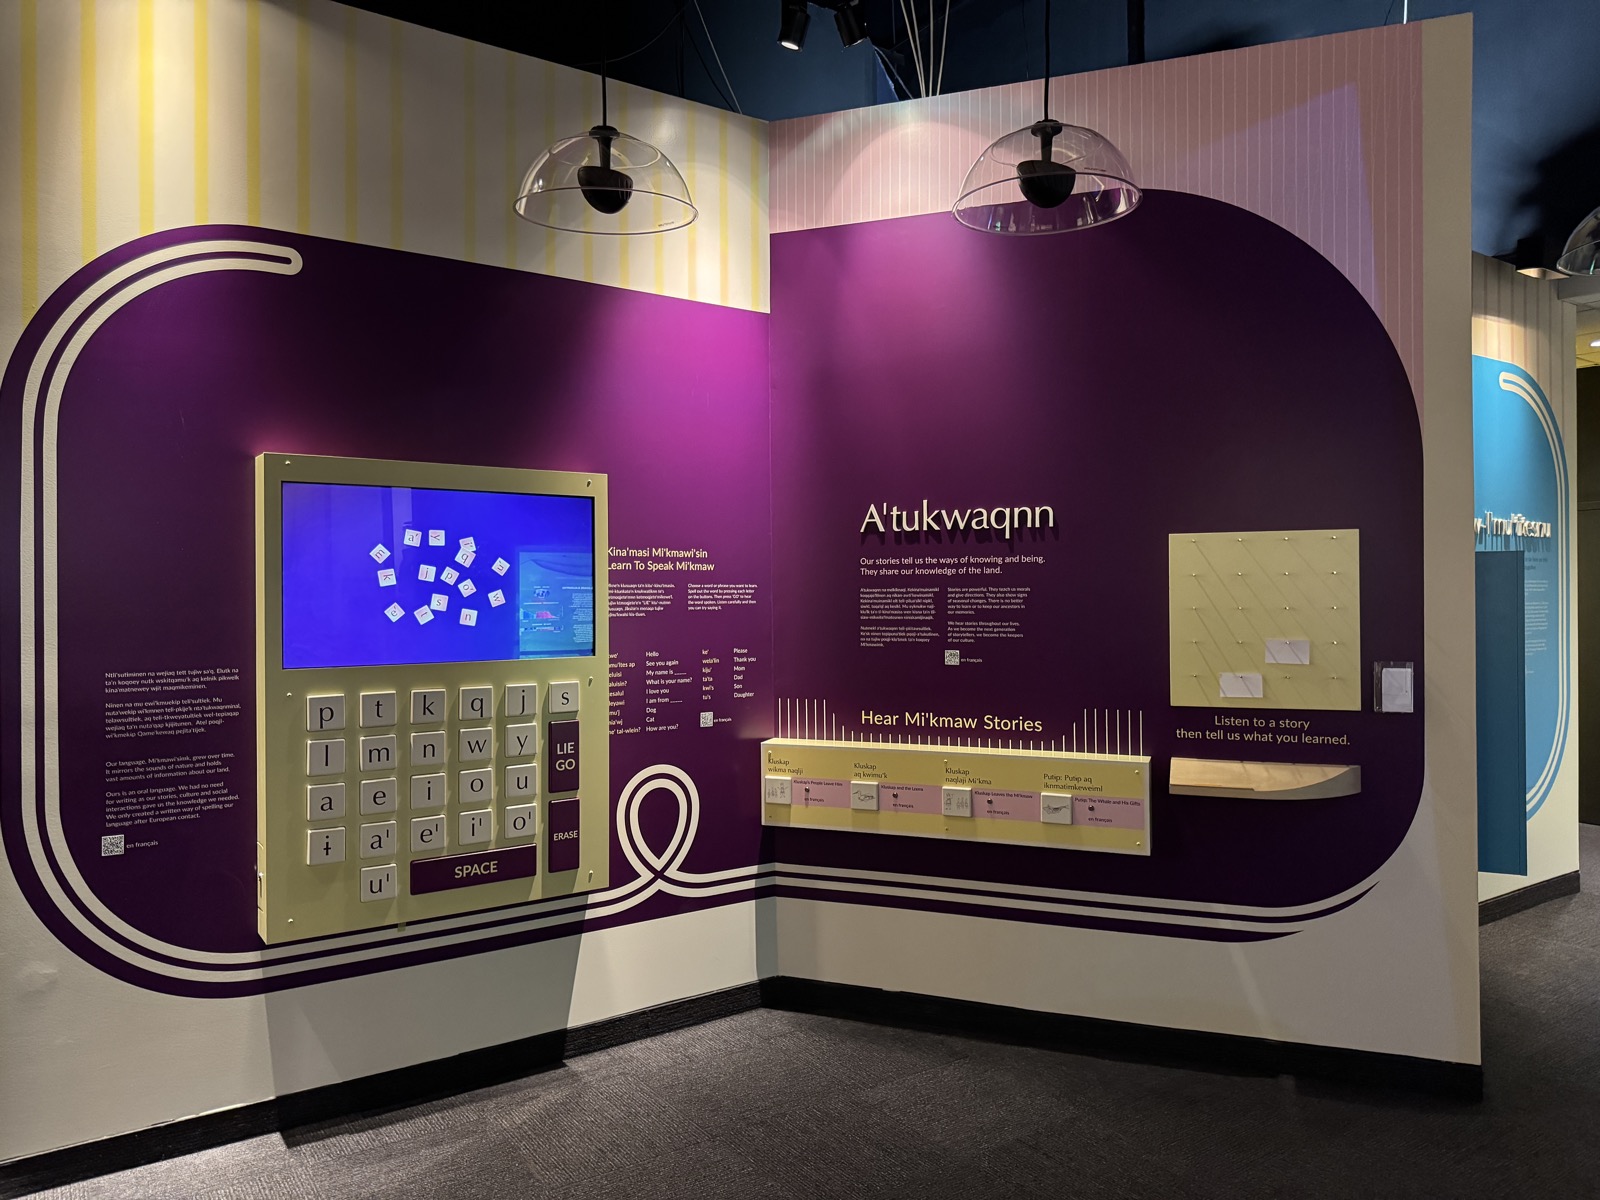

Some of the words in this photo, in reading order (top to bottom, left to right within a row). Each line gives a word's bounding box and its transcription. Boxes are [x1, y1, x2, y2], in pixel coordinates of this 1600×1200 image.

[860, 500, 1054, 539] A'tukwaqnn
[653, 548, 707, 558] Mi'kmawi'sin
[970, 556, 1003, 564] knowing
[1022, 555, 1046, 564] being.
[634, 561, 644, 570] To
[648, 561, 673, 572] Speak
[676, 562, 714, 571] Mi'kmaw
[860, 568, 877, 576] They
[915, 567, 956, 576] knowledge
[320, 707, 334, 729] p
[375, 701, 383, 718] t
[423, 695, 434, 715] k
[471, 698, 483, 718] q
[520, 690, 525, 715] j
[562, 692, 569, 705] s
[861, 711, 899, 725] Hear
[905, 711, 977, 730] Mi'kmaw
[984, 715, 1042, 732] Stories
[1215, 716, 1249, 726] Listen
[1253, 717, 1265, 727] to
[1280, 719, 1310, 730] story
[1176, 729, 1201, 738] then
[1206, 729, 1223, 740] tell
[1228, 732, 1240, 740] us
[1244, 731, 1272, 742] what
[1276, 734, 1298, 744] you
[1302, 733, 1350, 745] learned.
[369, 747, 389, 763] m
[423, 743, 435, 758] n
[468, 739, 487, 753] w
[517, 735, 528, 755] y
[557, 742, 574, 755] LIE
[556, 759, 575, 771] GO
[321, 796, 333, 811] a
[373, 791, 386, 805] e
[428, 781, 431, 800] i
[470, 779, 483, 792] o
[517, 776, 527, 789] u
[554, 831, 578, 841] ERASE
[455, 861, 498, 878] SPACE
